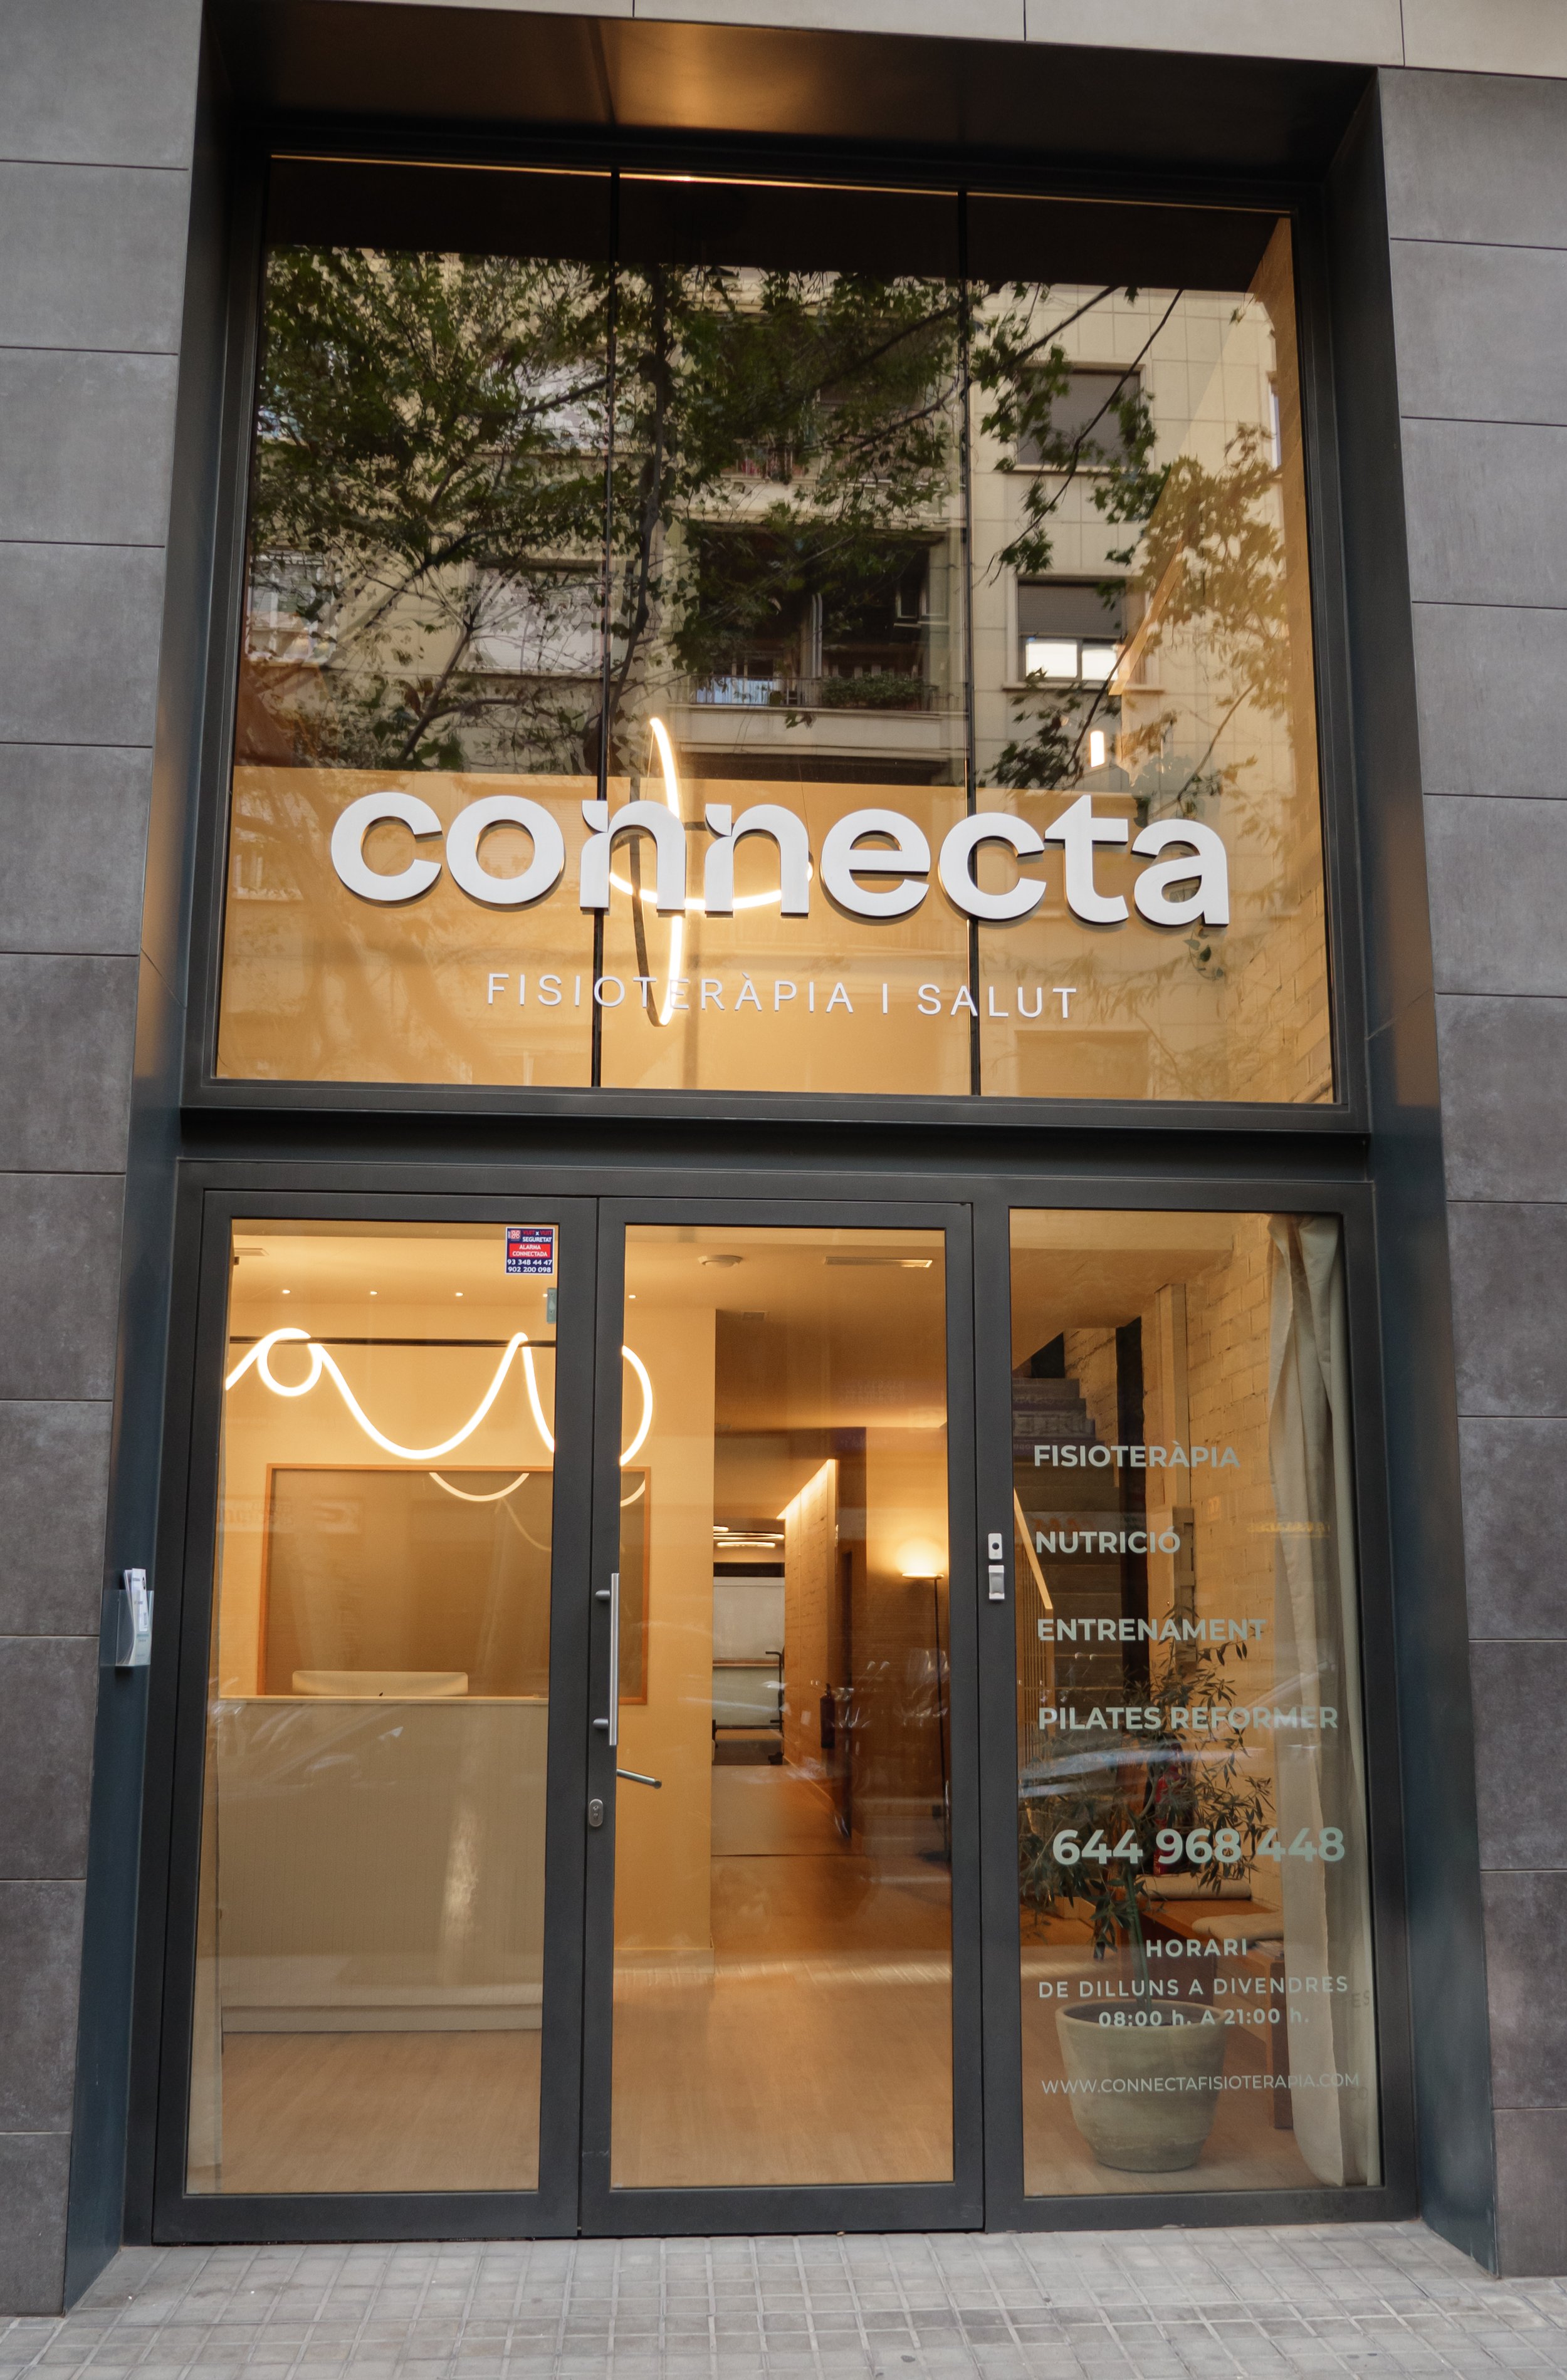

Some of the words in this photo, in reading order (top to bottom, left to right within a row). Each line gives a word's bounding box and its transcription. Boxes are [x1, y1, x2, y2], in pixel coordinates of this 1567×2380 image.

[331, 791, 1230, 926] connecta
[487, 972, 855, 1015] FISIOTERÀPIA
[881, 982, 889, 1014] I
[918, 983, 1077, 1019] SALUT
[1034, 1441, 1240, 1467] FISIOTERÀPIA
[1035, 1527, 1181, 1553] NUTRICIÓ
[1037, 1619, 1267, 1641] ENTRENAMENT
[1039, 1706, 1161, 1730] PILATES
[1171, 1706, 1339, 1728] REFORMER
[1052, 1829, 1143, 1865] 644
[1155, 1827, 1241, 1864] 968
[1256, 1826, 1345, 1862] 448
[1146, 1938, 1247, 1957] HORARI
[1039, 1981, 1068, 1998] DE
[1079, 1979, 1179, 1997] DILLUNS
[1188, 1978, 1203, 1995] A
[1213, 1976, 1348, 1994] DIVENDRES
[1099, 2010, 1163, 2027] 08:00
[1172, 2010, 1192, 2026] h.
[1200, 2009, 1215, 2025] A
[1224, 2008, 1281, 2024] 21:00
[1289, 2007, 1309, 2023] h.
[1041, 2073, 1360, 2094] WWW.CONNECTAFISIOTERAPIA.COM
